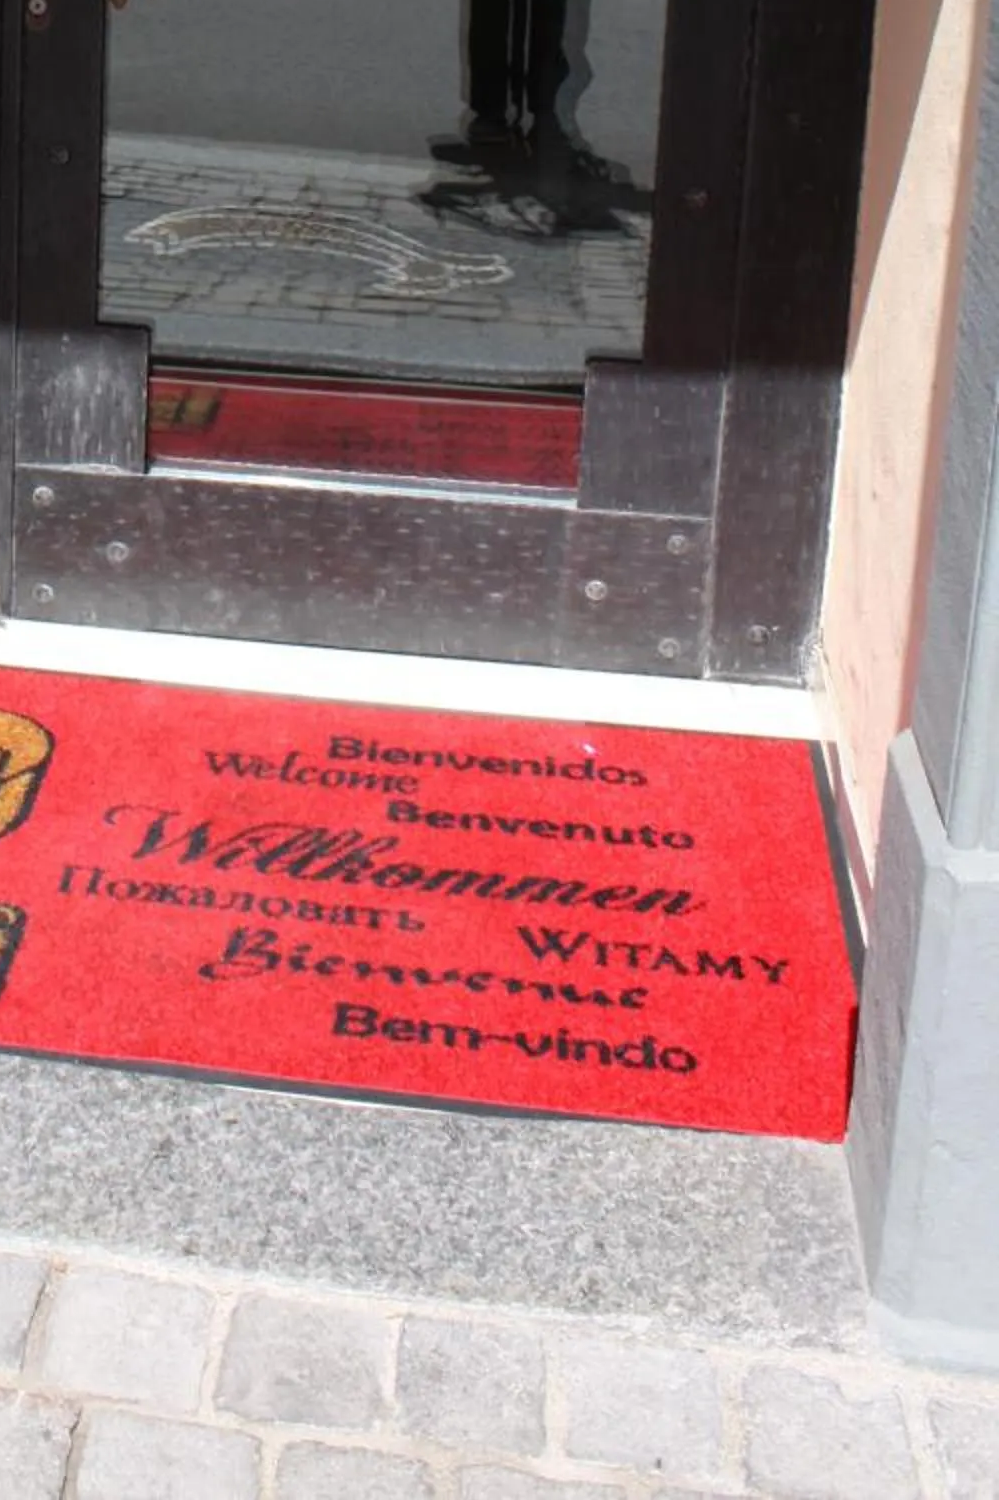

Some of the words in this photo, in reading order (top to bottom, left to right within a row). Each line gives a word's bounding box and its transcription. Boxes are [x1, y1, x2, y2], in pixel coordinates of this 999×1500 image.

[204, 750, 421, 795] Welcome
[327, 735, 648, 787] Bienvenidos
[386, 800, 695, 851] Benvenuto
[104, 803, 706, 916] Willkommen
[197, 926, 650, 1010] Bienvenue
[517, 925, 790, 986] WITAMY
[331, 1002, 698, 1075] Bem-vindo
